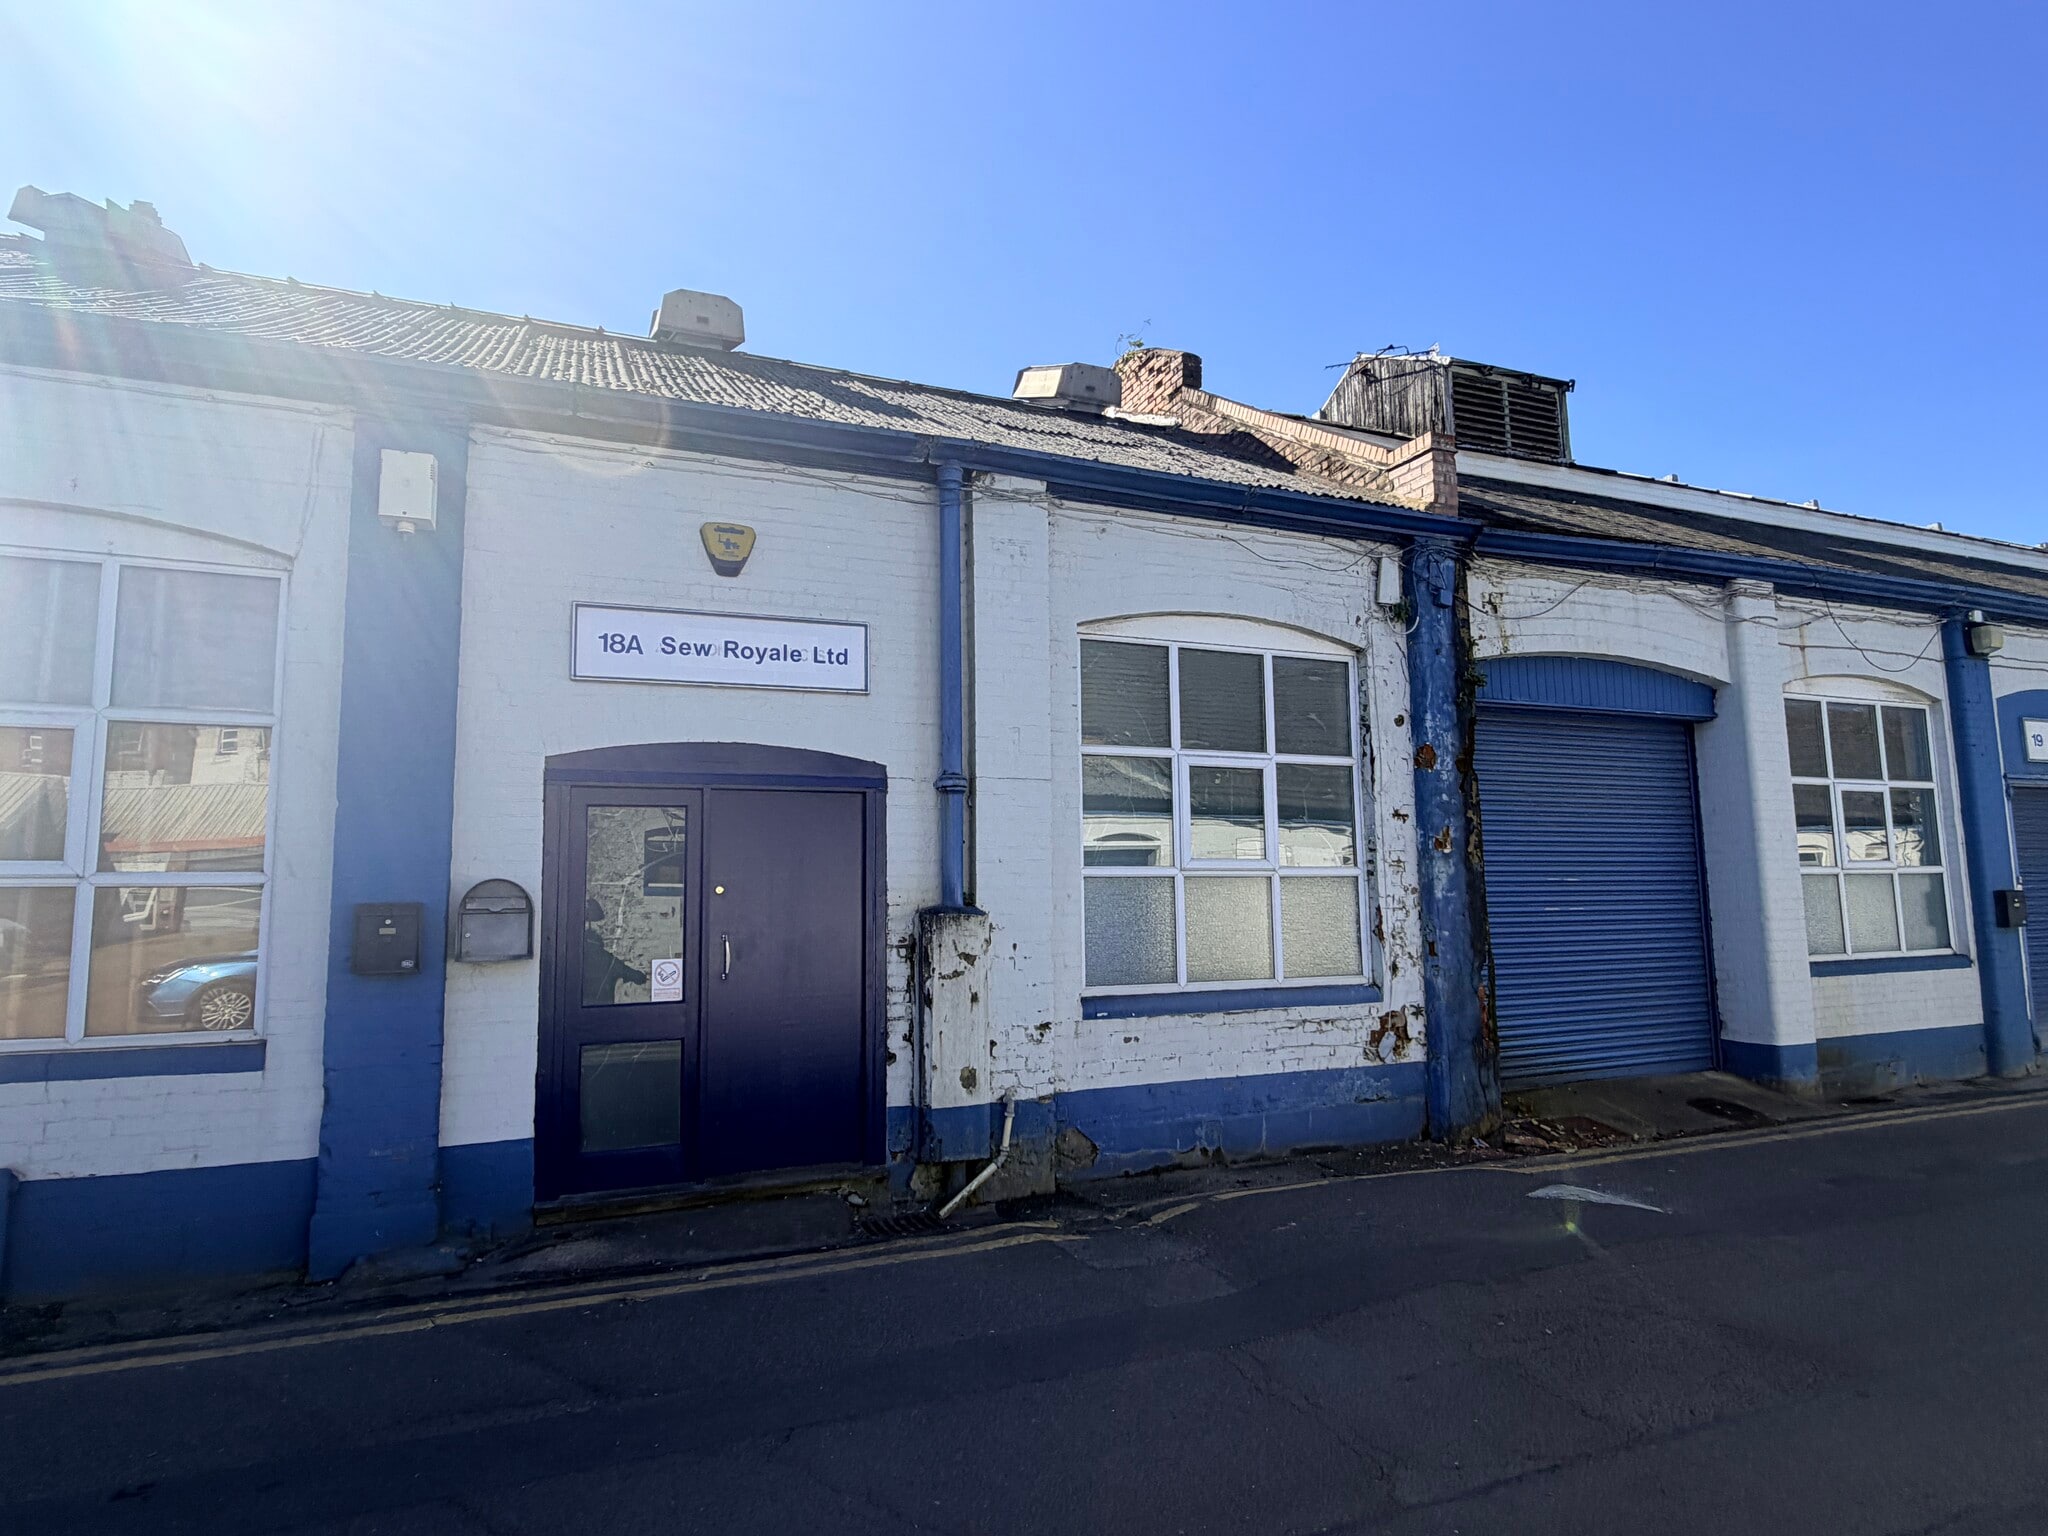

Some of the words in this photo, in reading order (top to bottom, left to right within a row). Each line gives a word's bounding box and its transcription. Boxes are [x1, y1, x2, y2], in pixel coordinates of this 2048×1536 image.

[598, 632, 644, 655] 18A
[660, 636, 713, 657] Sew
[723, 639, 803, 665] Royale
[812, 645, 849, 666] Ltd
[2031, 733, 2044, 747] 19
